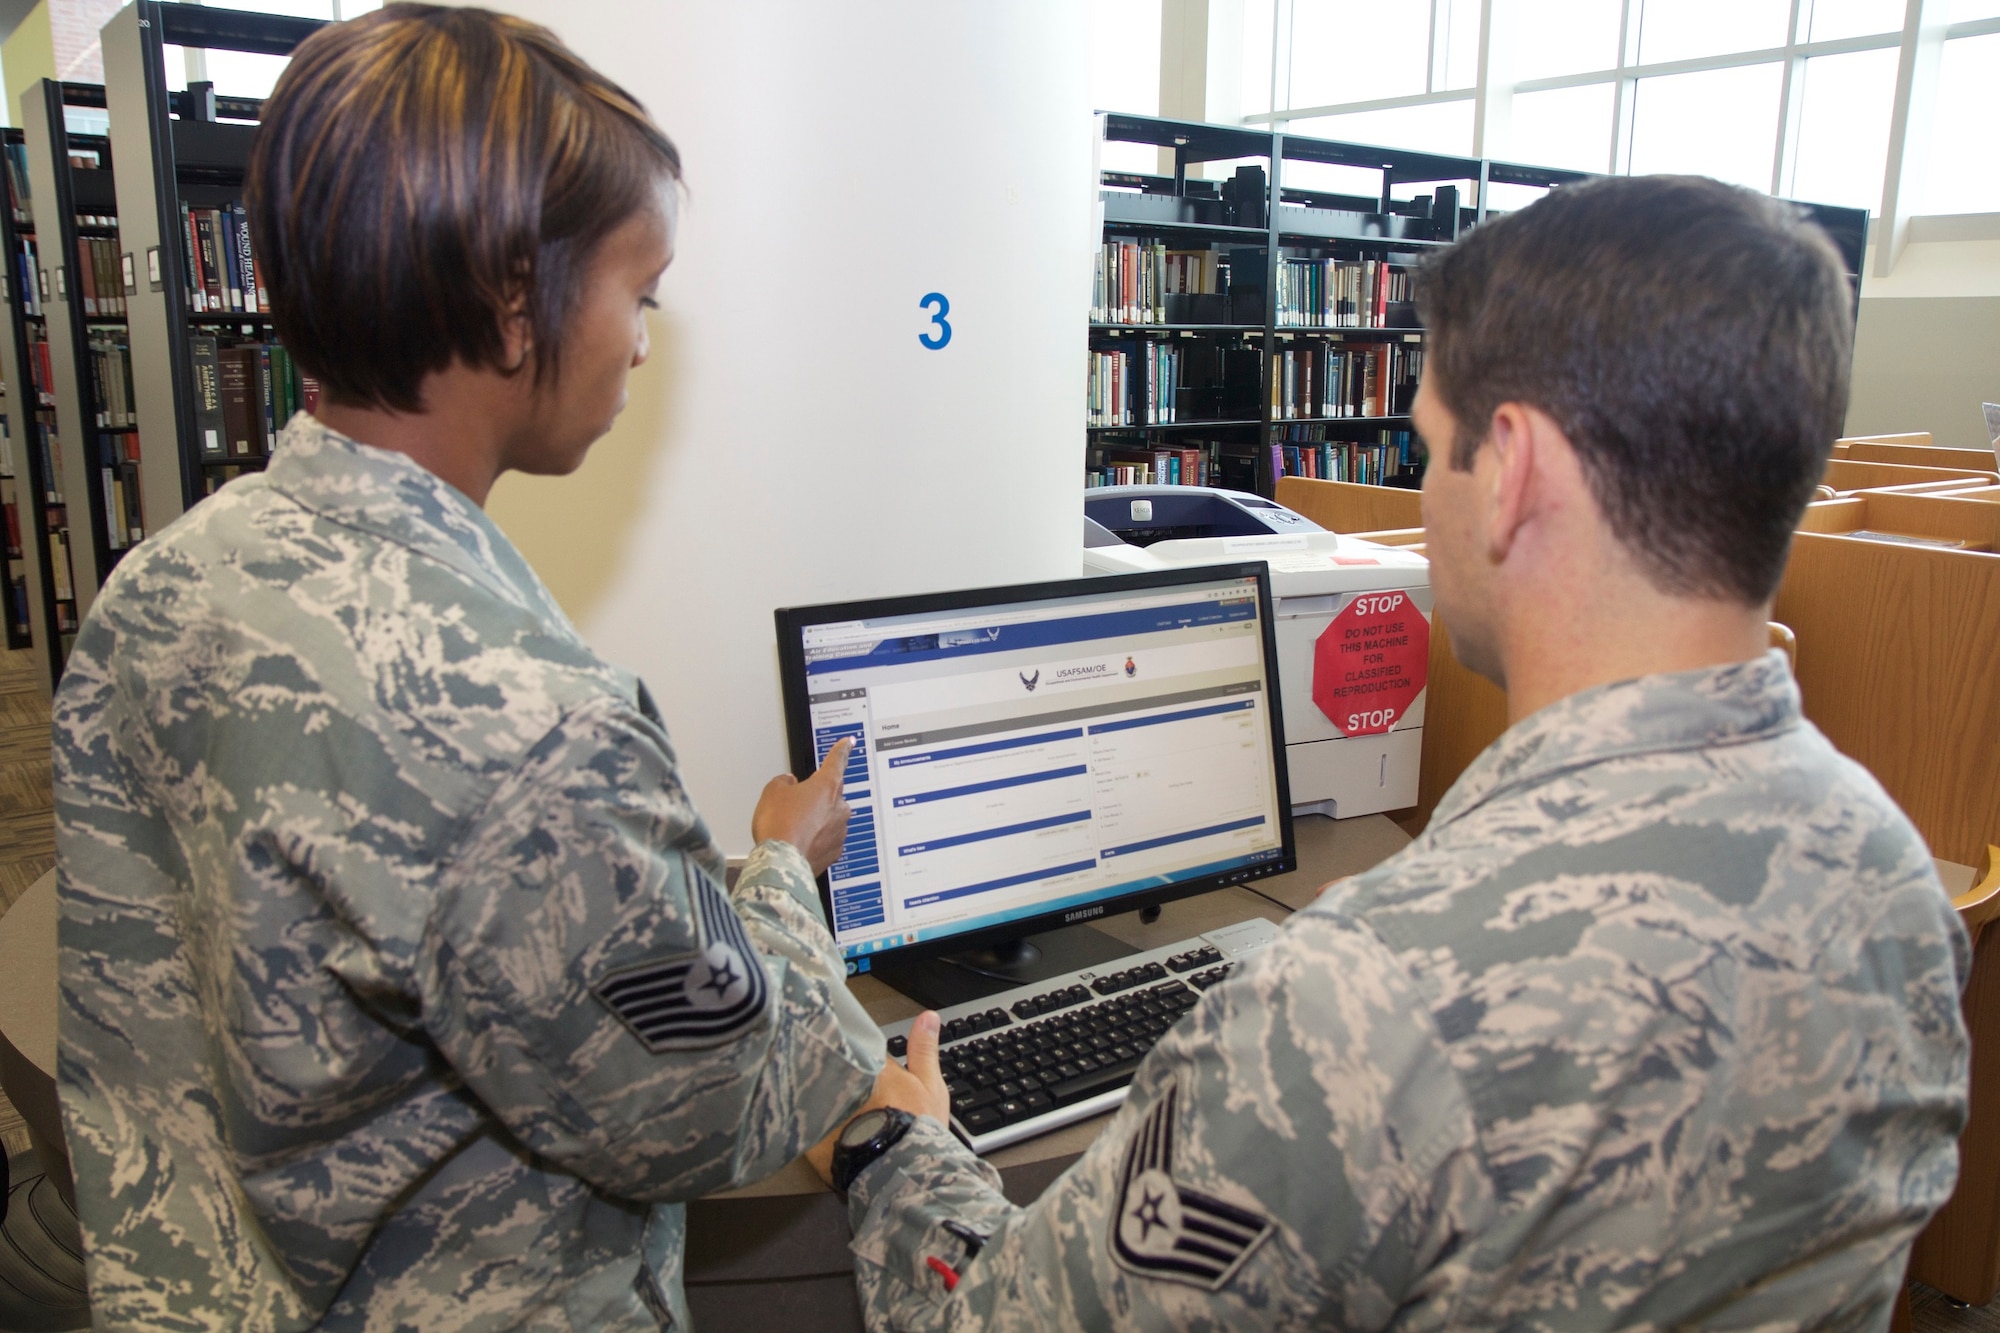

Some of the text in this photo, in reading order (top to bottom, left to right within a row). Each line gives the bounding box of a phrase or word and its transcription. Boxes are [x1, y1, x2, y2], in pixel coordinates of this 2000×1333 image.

[240, 221, 252, 256] WOUND
[918, 292, 952, 350] 3
[201, 365, 213, 410] ANESTHESIA
[208, 364, 218, 409] CLINICAL
[1355, 595, 1403, 616] STOP
[1345, 622, 1404, 639] DO NOT USE
[835, 649, 870, 657] Command
[1340, 636, 1408, 654] THIS MACHINE
[1363, 653, 1383, 664] FOR
[1056, 664, 1106, 678] USAFSAM/OE
[1345, 665, 1402, 682] CLASSIFIED
[1334, 678, 1411, 698] REPRODUCTION
[1348, 708, 1394, 731] STOP
[1065, 906, 1104, 922] SAMSUNG
